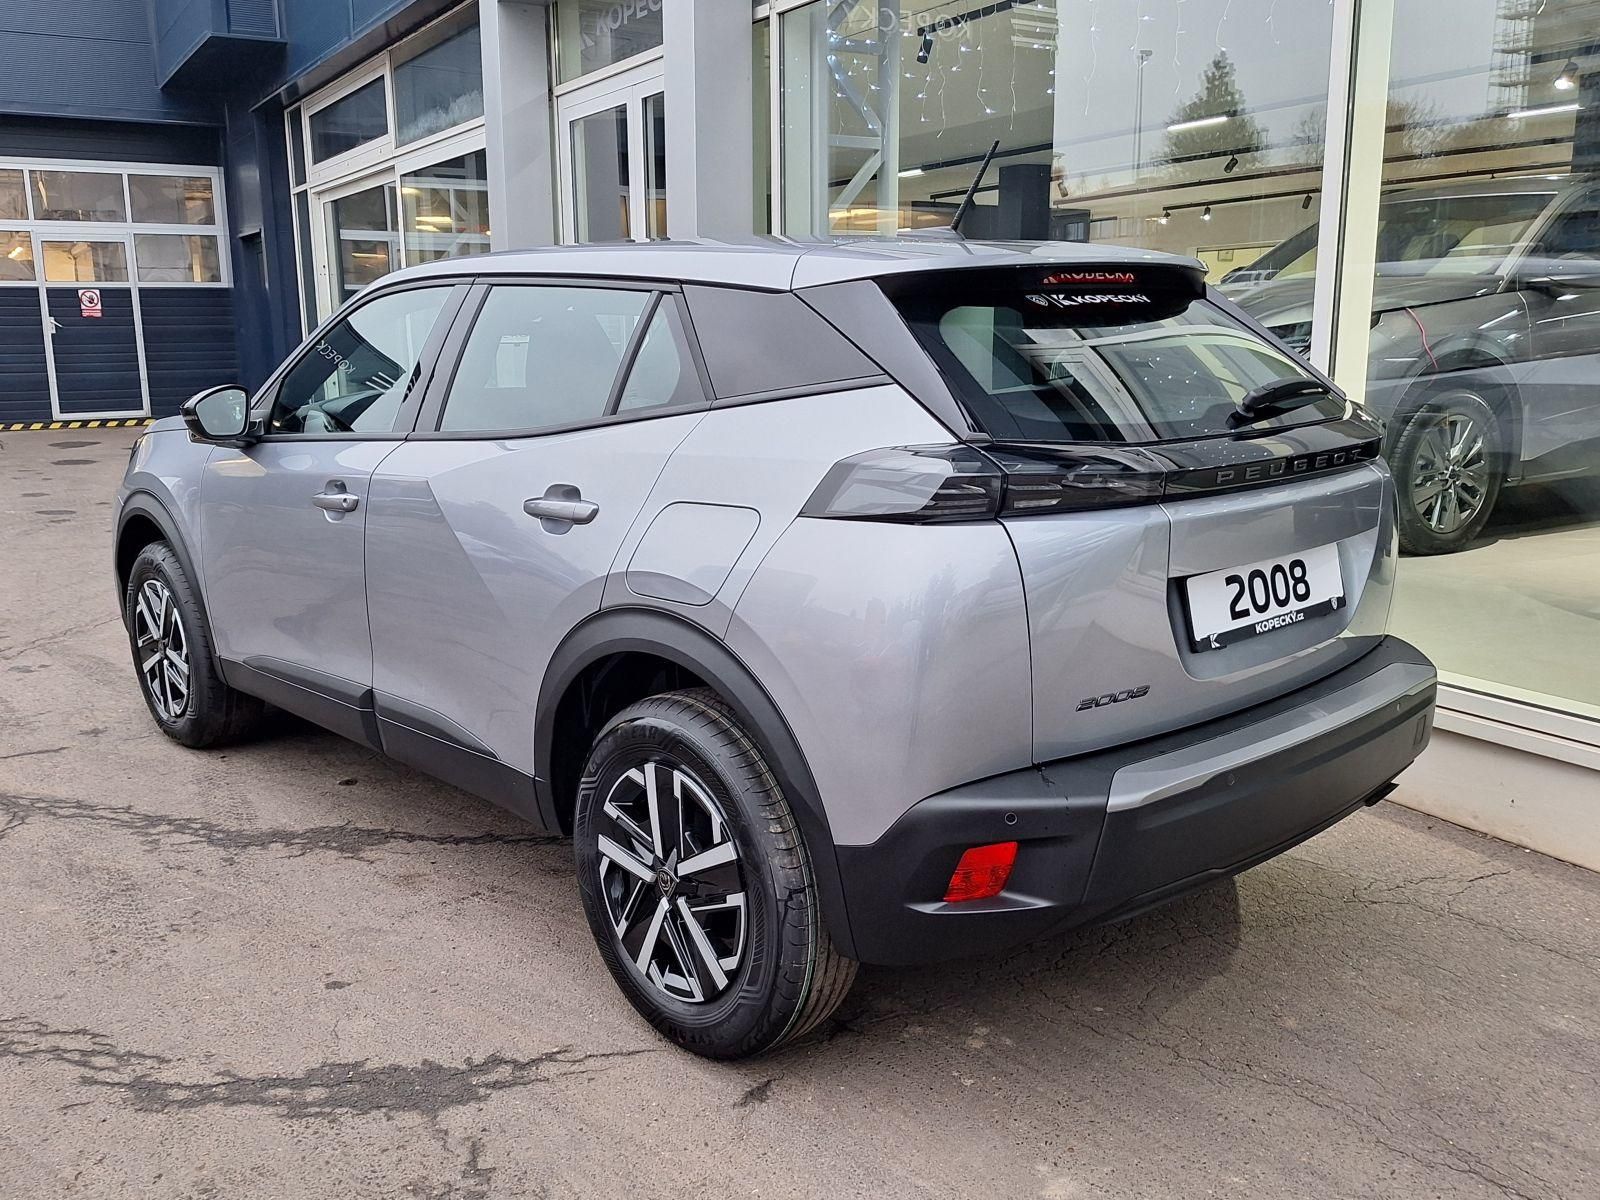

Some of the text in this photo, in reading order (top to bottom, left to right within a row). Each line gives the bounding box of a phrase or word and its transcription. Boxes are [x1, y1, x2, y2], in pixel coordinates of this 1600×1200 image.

[1216, 449, 1362, 484] PEUGEOT
[1224, 558, 1311, 622] 2008
[1075, 685, 1151, 713] 2008
